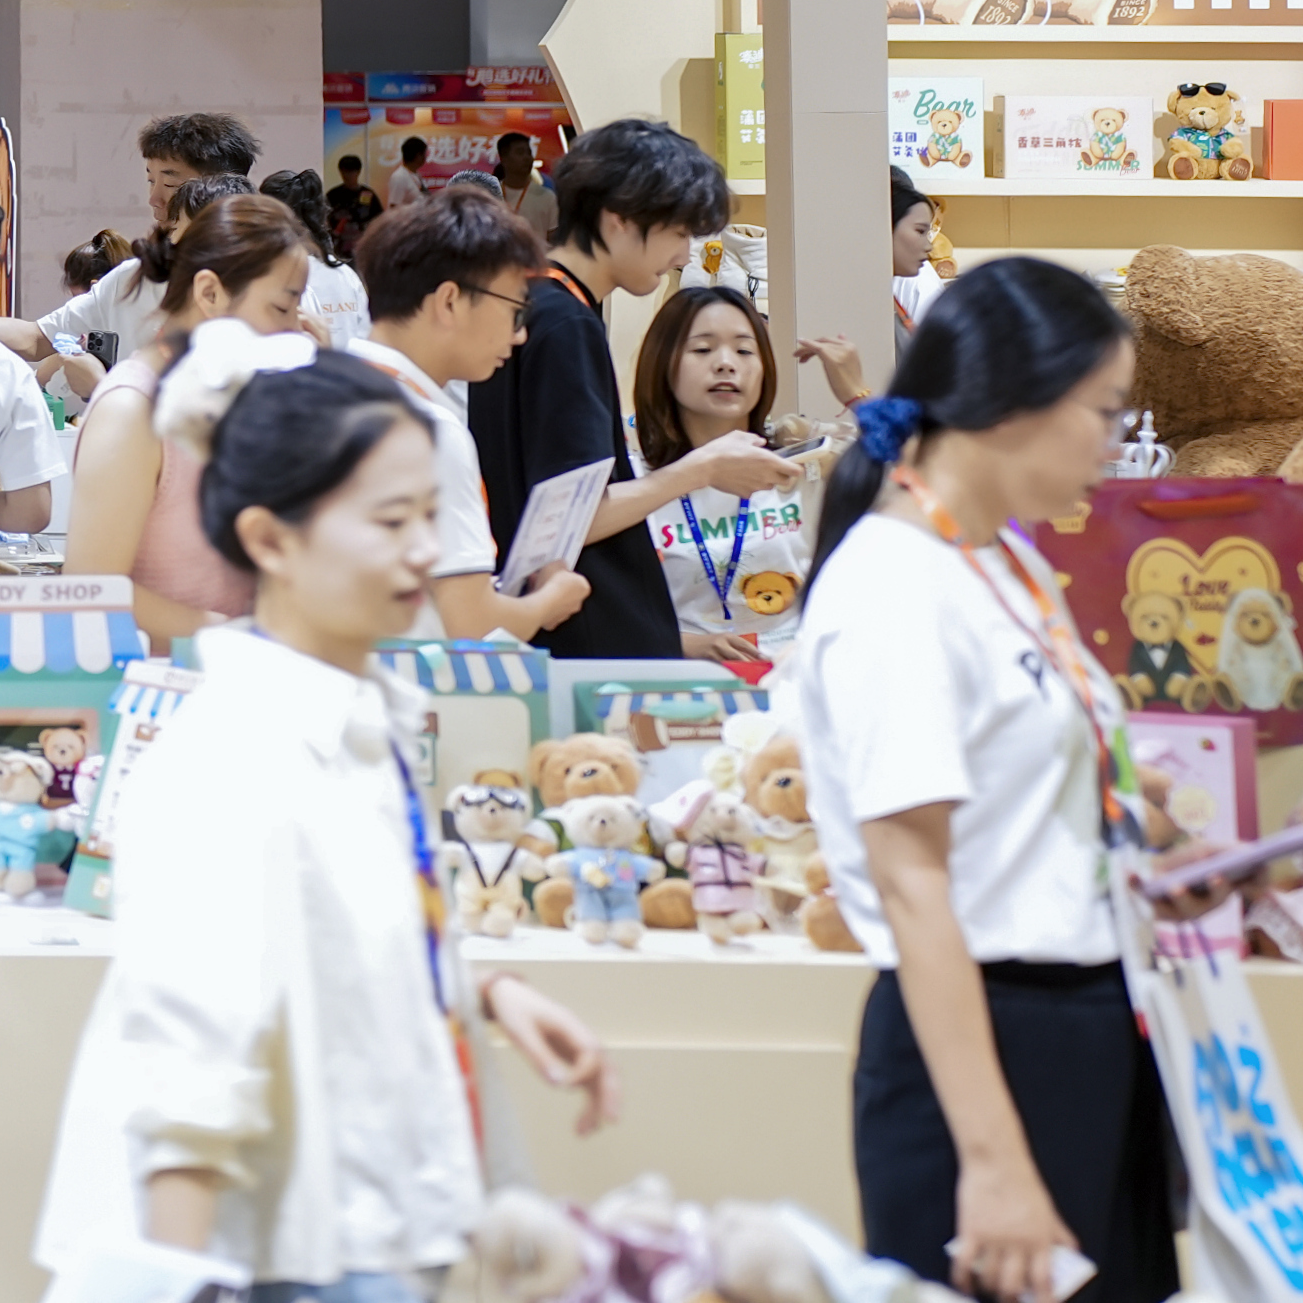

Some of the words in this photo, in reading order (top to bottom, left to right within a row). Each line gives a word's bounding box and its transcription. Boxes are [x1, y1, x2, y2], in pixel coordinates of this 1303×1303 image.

[1113, 6, 1145, 19] 1892
[913, 89, 976, 118] Bear
[41, 584, 103, 601] SHOP
